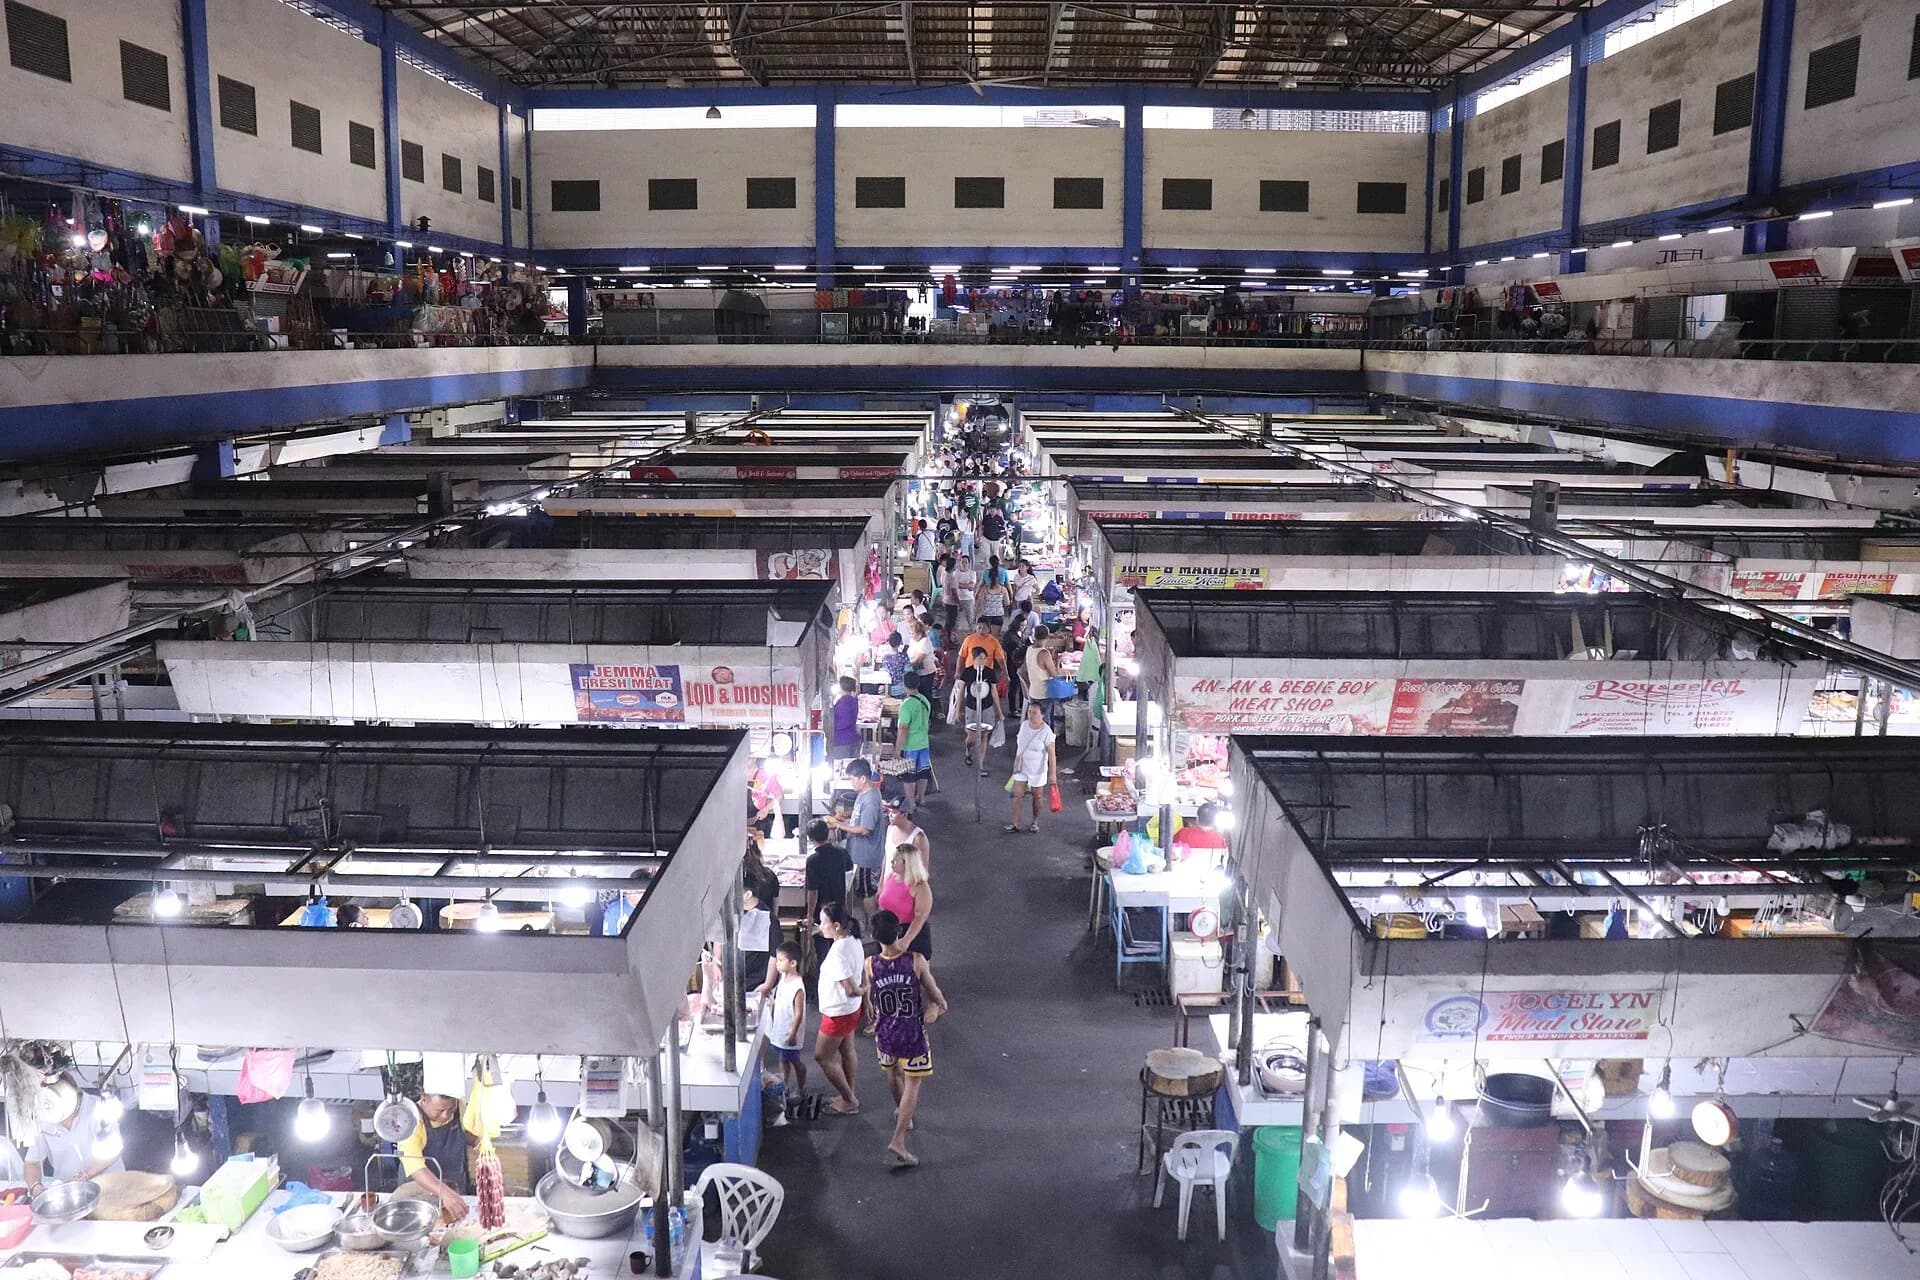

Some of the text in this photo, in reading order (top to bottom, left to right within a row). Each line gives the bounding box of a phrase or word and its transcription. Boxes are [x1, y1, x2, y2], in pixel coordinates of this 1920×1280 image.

[593, 666, 658, 678] JEMMA
[581, 678, 671, 689] FRESH MEAT
[1191, 679, 1376, 694] AN-AN & BEBIE BOY
[1579, 679, 1656, 701] Roy
[685, 681, 798, 708] LOU & DIOSING
[1229, 697, 1335, 712] MEAT SHOP
[1626, 700, 1655, 708] MEAT
[1214, 714, 1241, 723] PORK
[1252, 714, 1276, 723] BEEF
[1278, 713, 1319, 724] TENDER
[880, 987, 914, 1018] 05
[1500, 992, 1656, 1009] JOCELYN
[1495, 1012, 1642, 1032] Meat Store
